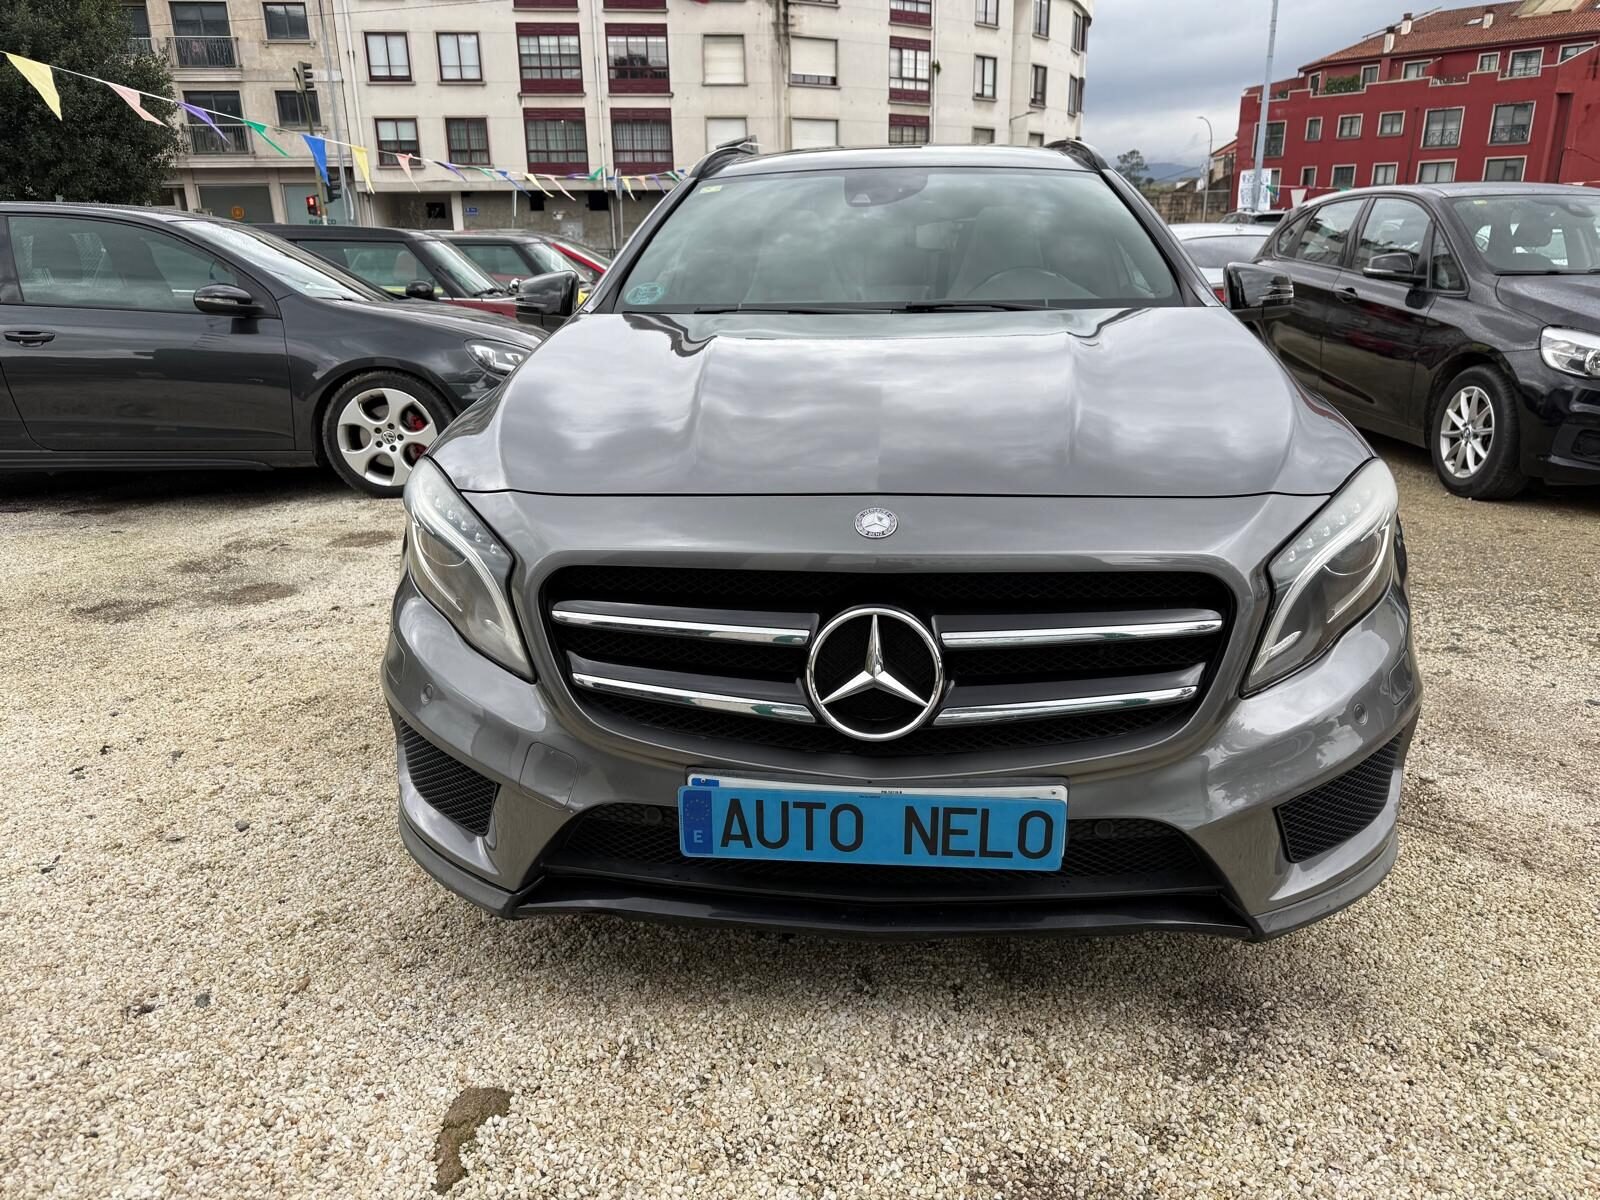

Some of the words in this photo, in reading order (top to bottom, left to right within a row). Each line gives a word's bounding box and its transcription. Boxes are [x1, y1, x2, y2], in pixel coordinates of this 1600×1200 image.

[693, 830, 704, 843] E
[720, 798, 864, 853] AUTO
[903, 806, 1055, 860] NELO
